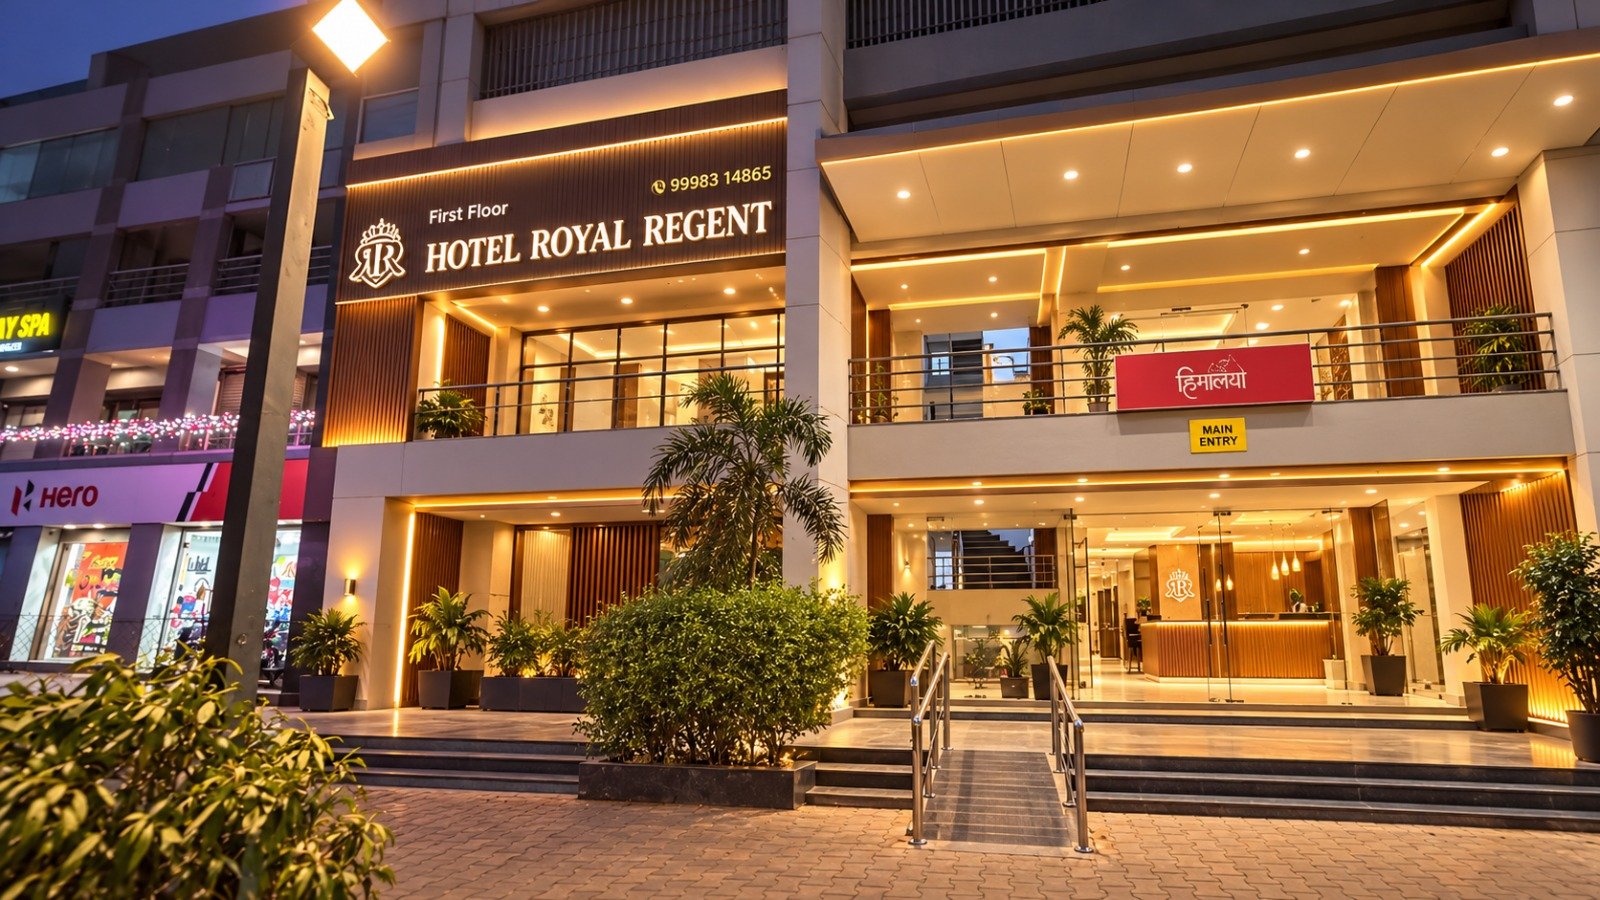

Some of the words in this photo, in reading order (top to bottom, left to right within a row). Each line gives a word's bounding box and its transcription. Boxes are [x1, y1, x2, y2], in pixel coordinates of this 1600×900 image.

[670, 172, 719, 192] 99983
[724, 165, 772, 185] 14865
[429, 209, 464, 225] First
[468, 203, 509, 219] Floor
[424, 233, 521, 273] HOTEL
[530, 219, 632, 260] ROYAL
[642, 200, 773, 247] REGENT
[17, 312, 50, 338] SPA
[1199, 435, 1238, 447] ENTRY
[1202, 424, 1233, 435] MAIN
[39, 485, 99, 508] Hero
